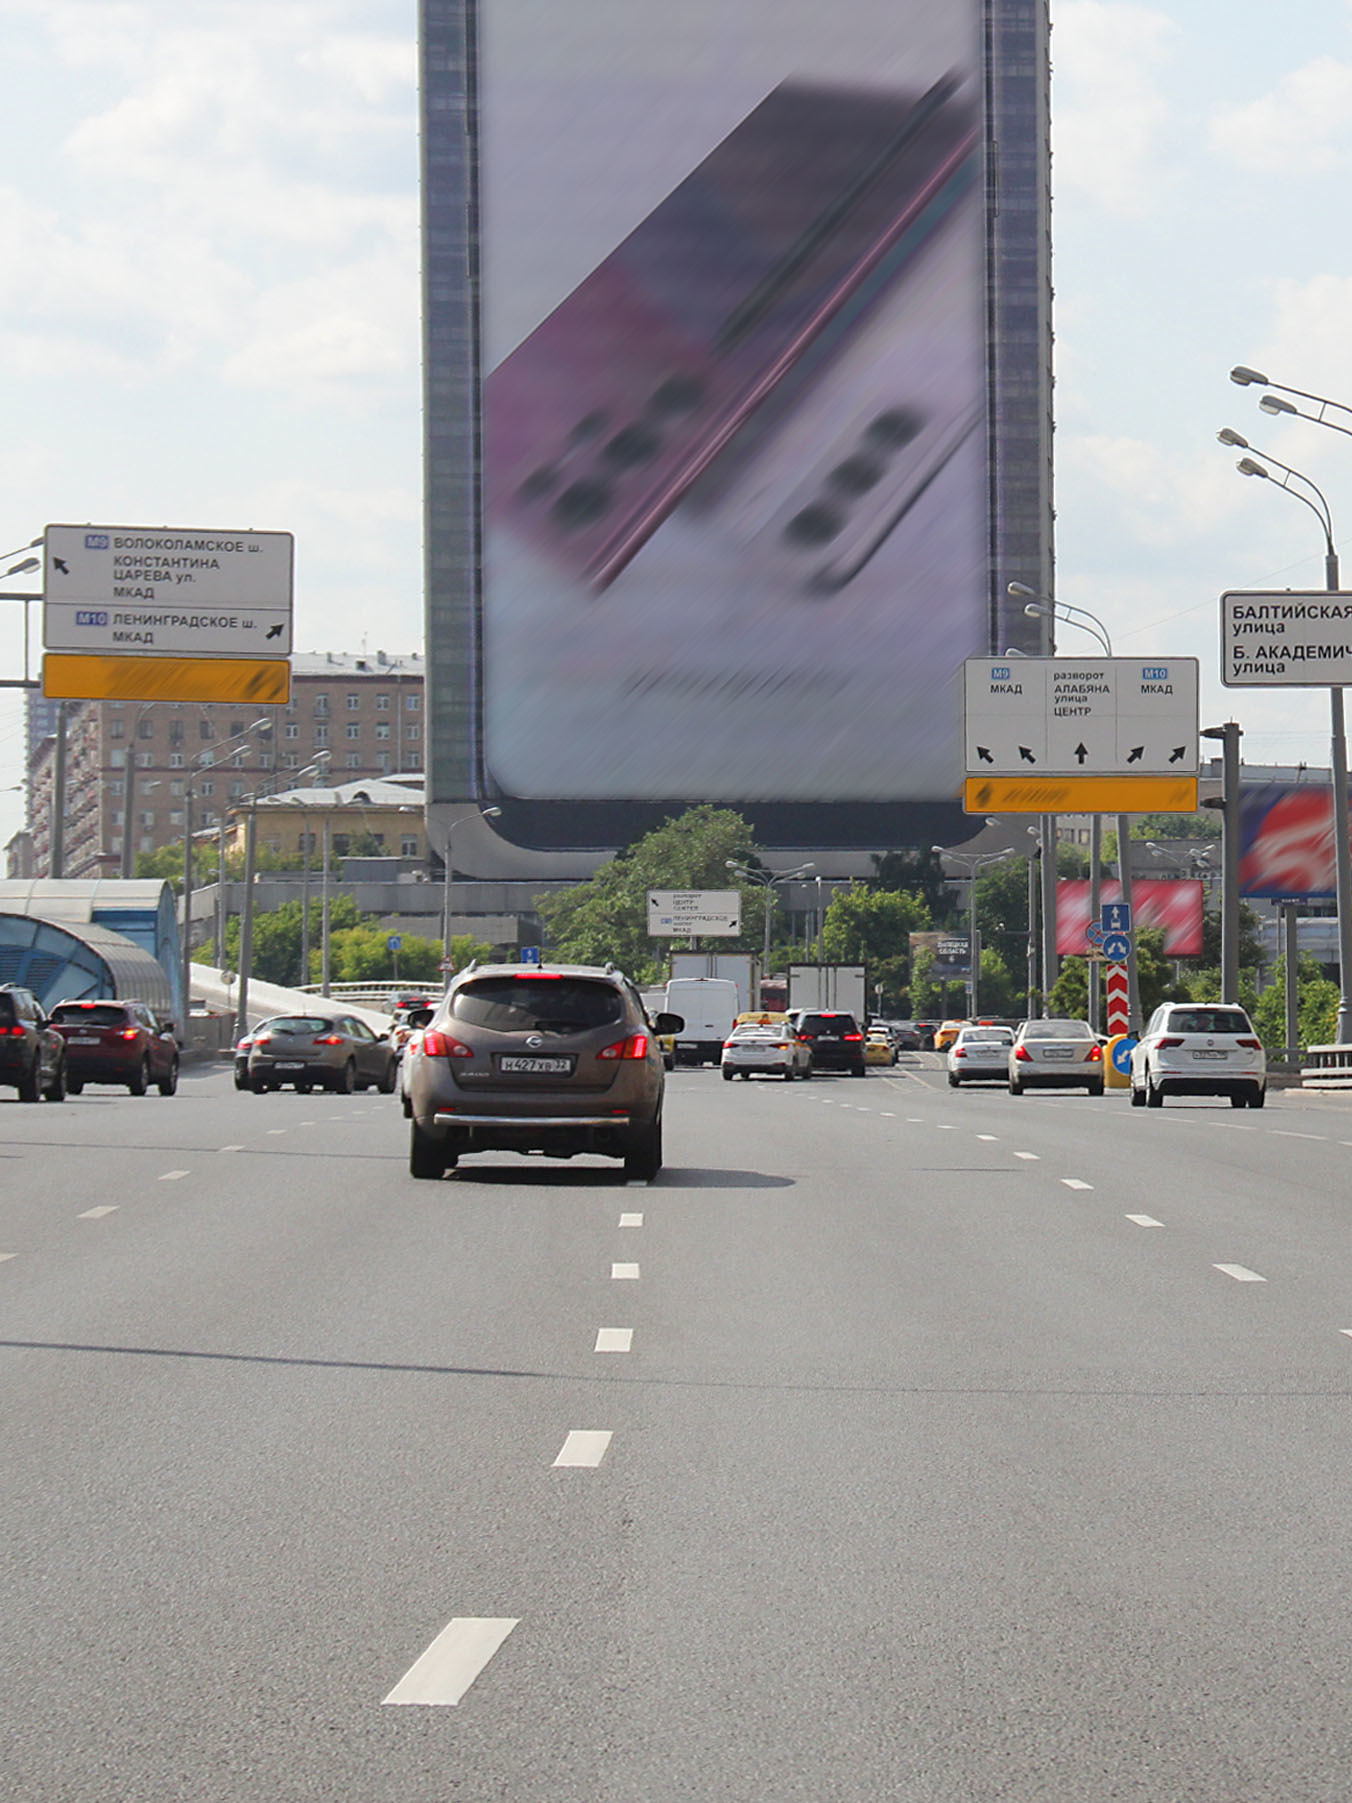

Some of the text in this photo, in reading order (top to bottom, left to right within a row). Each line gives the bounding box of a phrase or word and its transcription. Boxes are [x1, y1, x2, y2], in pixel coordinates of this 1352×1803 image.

[114, 538, 244, 552] ВОЛОКОЛАМСКОЕ
[248, 543, 264, 553] ш.
[114, 555, 221, 570] КОНСТАНТИНА
[114, 568, 196, 584] ЦАРЕВА ул.
[114, 586, 155, 600] МКАД
[113, 613, 238, 629] ЛЕНИНГРАДСКОЕ
[242, 619, 258, 630] ш.
[1232, 622, 1286, 637] улица
[113, 630, 154, 645] МКАД
[1233, 645, 1250, 659] Б.
[1053, 671, 1105, 682] разворот
[1233, 662, 1286, 677] улица
[990, 684, 1023, 695] МКАД
[1054, 684, 1110, 694] АЛАБЯНА
[1141, 684, 1174, 695] МКАД
[1054, 694, 1088, 704] улица
[1054, 706, 1092, 717] ЦЕНТР
